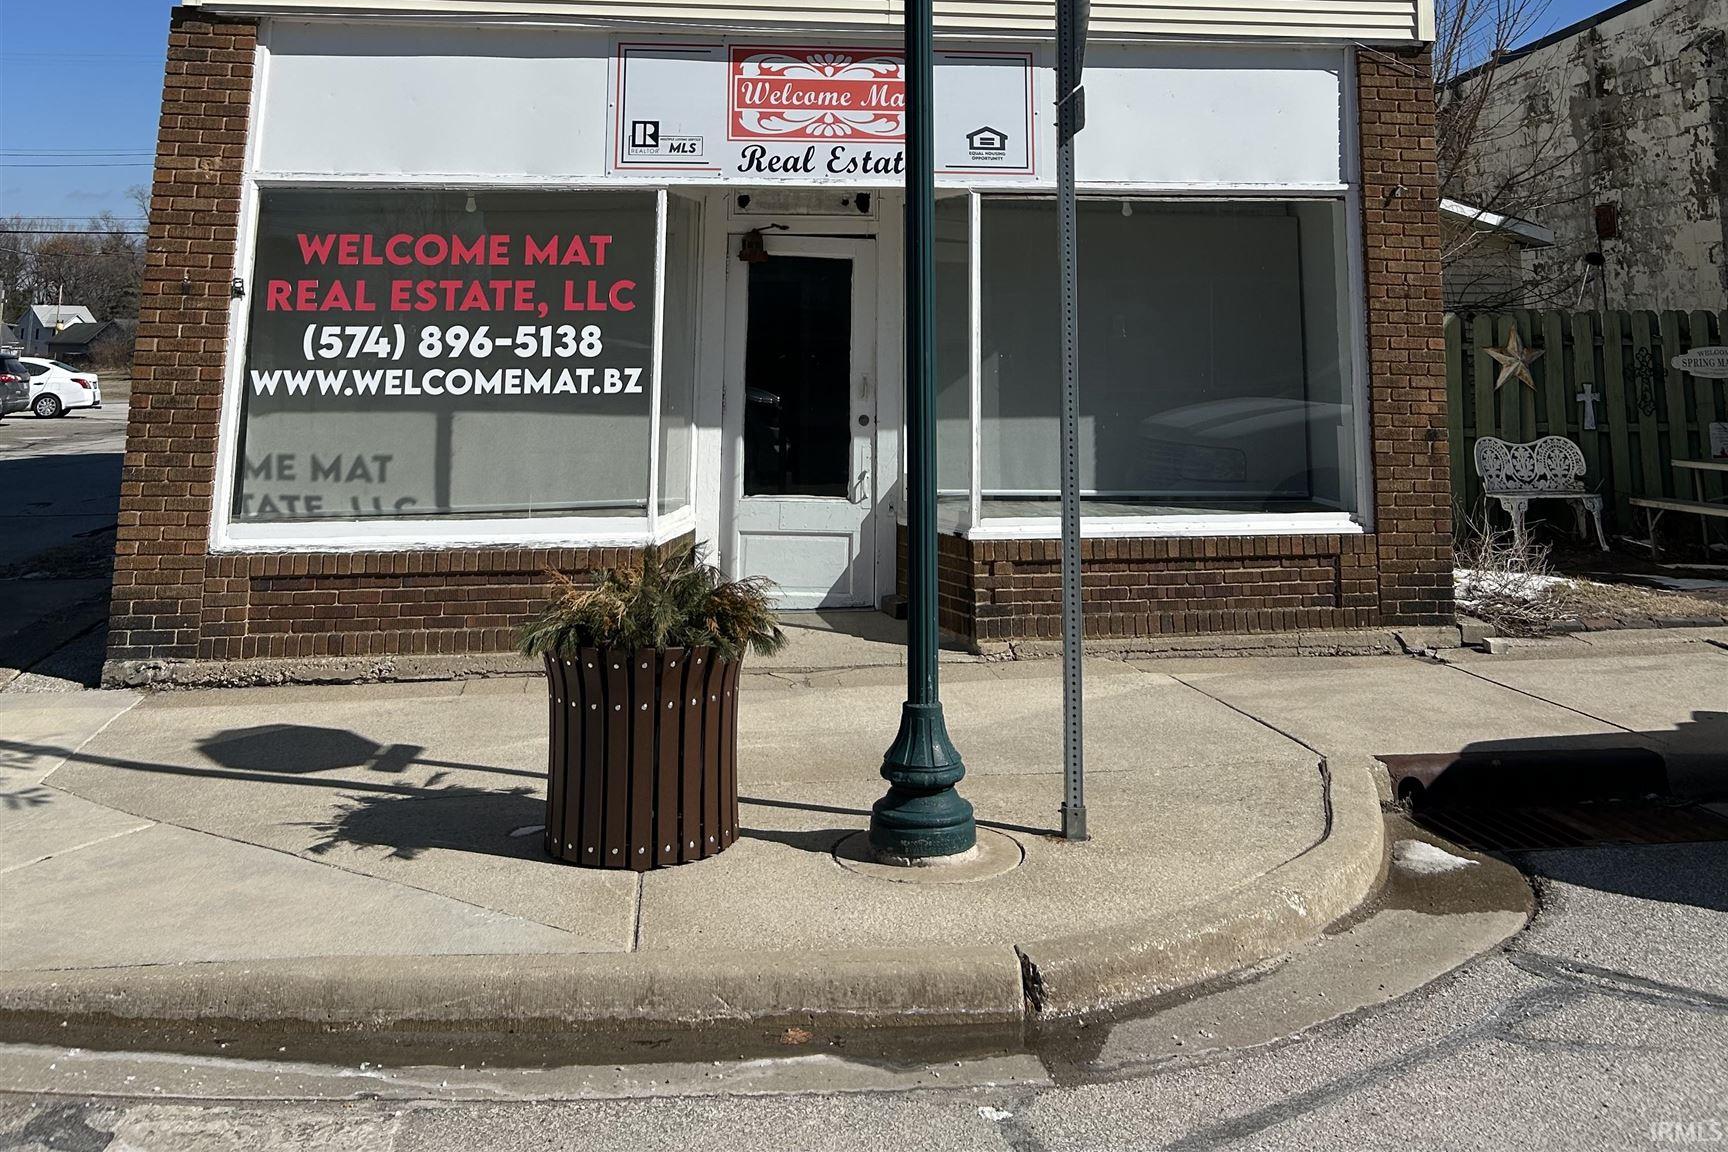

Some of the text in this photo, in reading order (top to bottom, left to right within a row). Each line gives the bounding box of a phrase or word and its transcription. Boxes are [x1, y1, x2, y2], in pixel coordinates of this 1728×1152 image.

[741, 81, 905, 107] Welcome Ma
[669, 143, 697, 154] MLS
[737, 144, 905, 174] Real Estat
[296, 234, 613, 266] WELCOME MAT
[266, 279, 637, 318] REAL ESTATE, LLC
[303, 324, 603, 360] (574) 896-5138
[1681, 358, 1716, 368] SPRING
[250, 368, 643, 396] WWW.WELCOMEMAT.BZ
[310, 453, 393, 483] MAT
